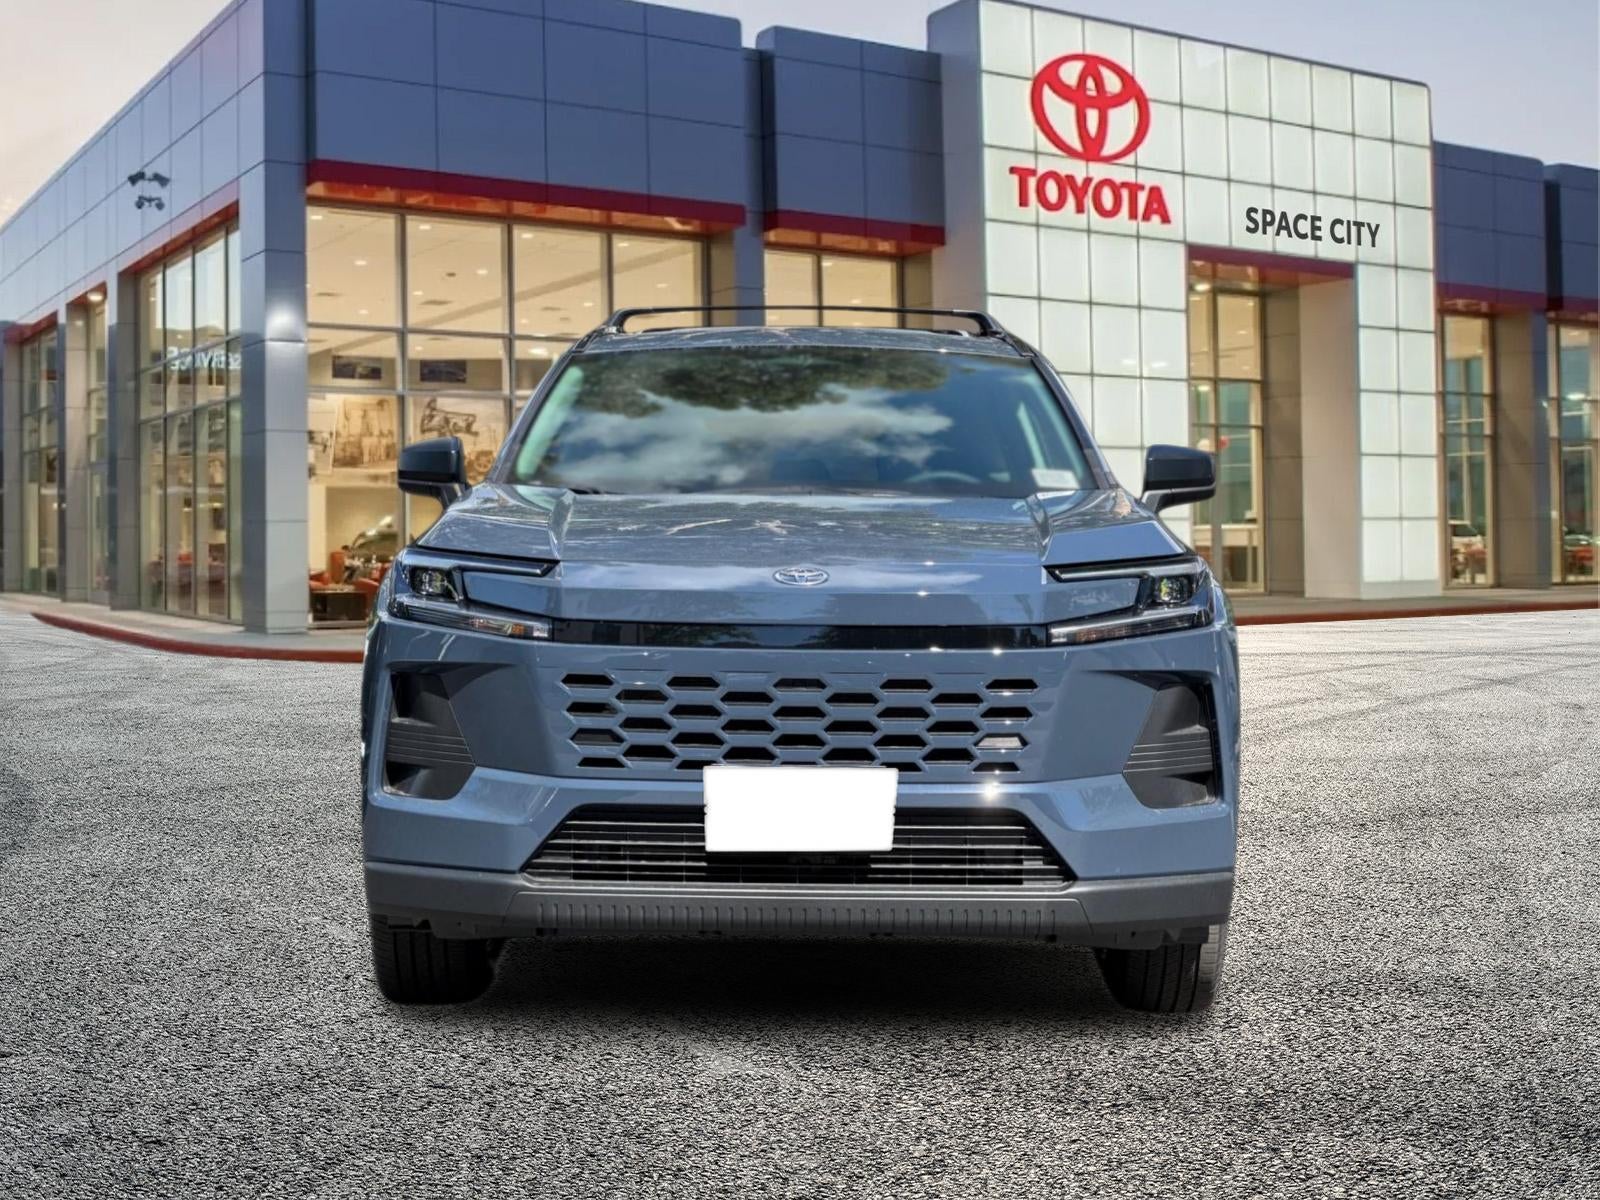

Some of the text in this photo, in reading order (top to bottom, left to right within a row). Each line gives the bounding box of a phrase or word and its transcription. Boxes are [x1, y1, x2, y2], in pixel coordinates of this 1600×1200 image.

[1009, 166, 1171, 224] TOYOTA
[1245, 206, 1380, 248] SPACE CITY
